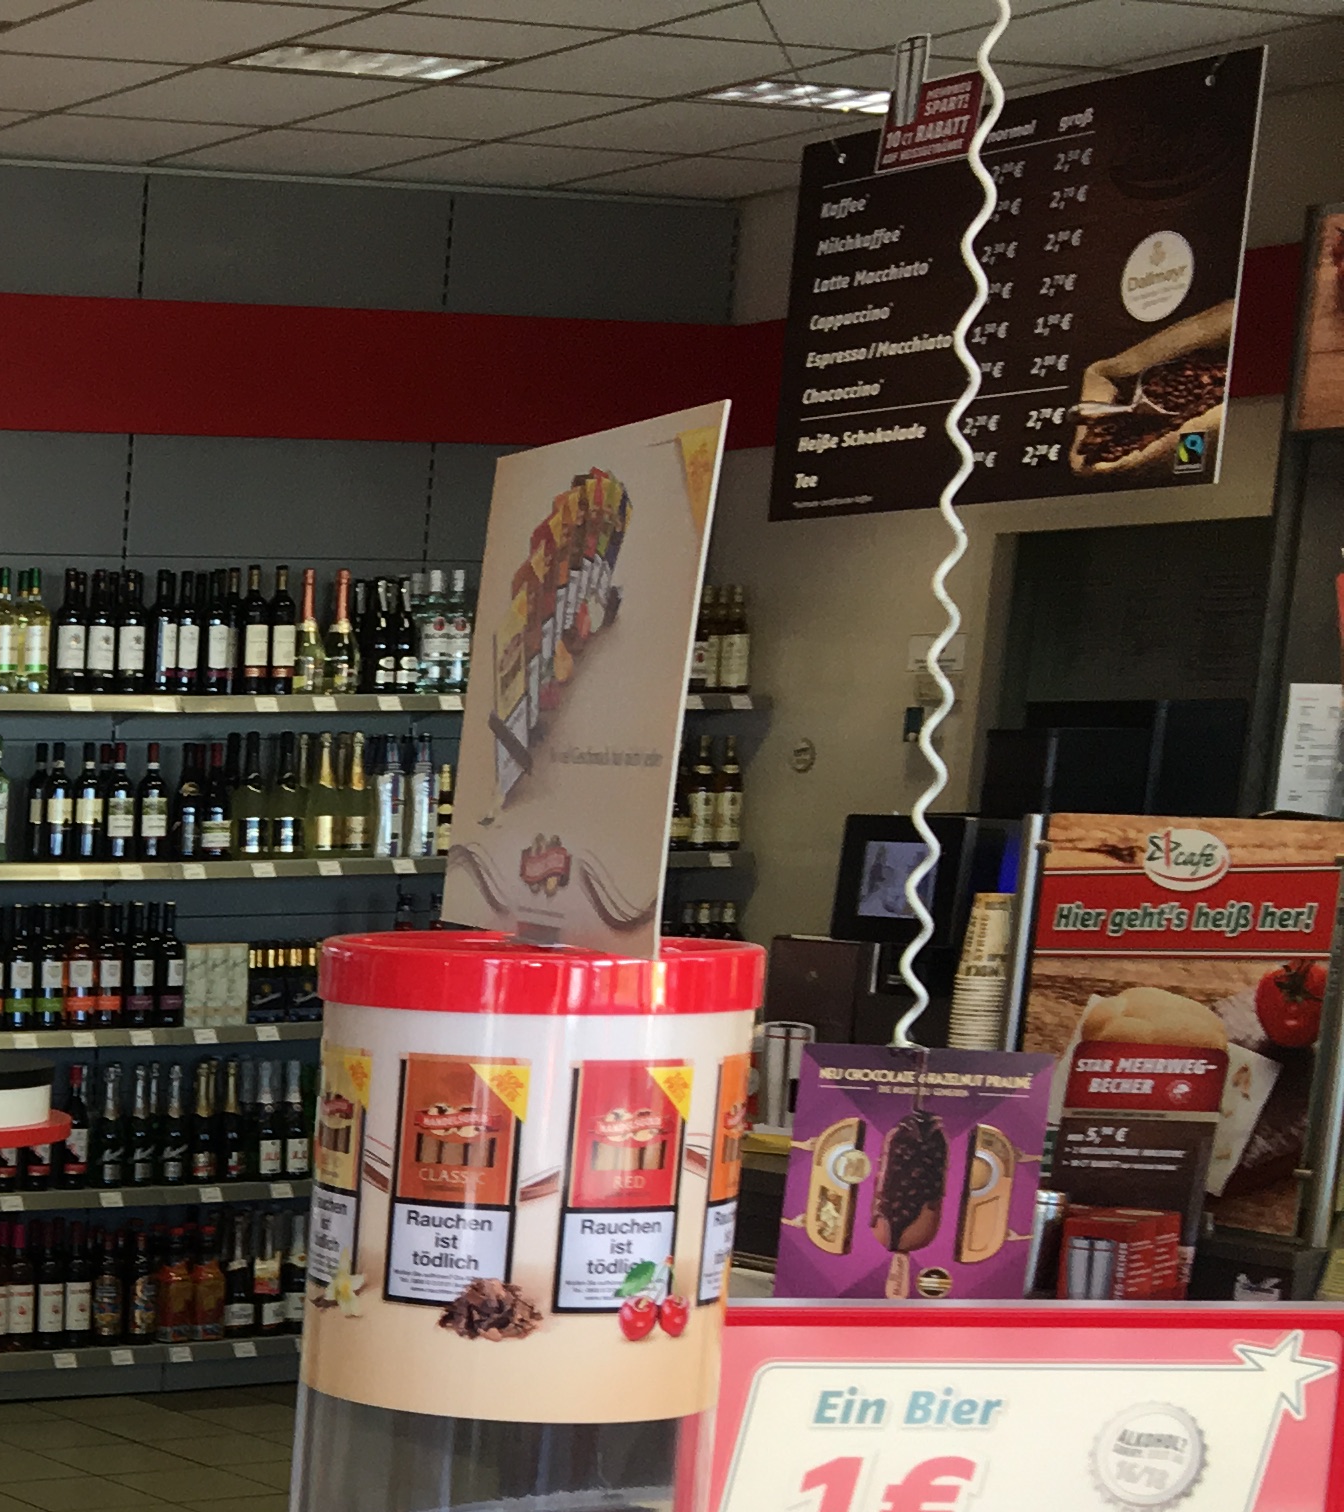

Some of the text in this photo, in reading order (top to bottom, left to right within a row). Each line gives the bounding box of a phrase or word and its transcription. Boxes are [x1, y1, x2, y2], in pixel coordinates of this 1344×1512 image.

[915, 115, 970, 142] RABATT
[986, 119, 1037, 144] normal
[842, 423, 926, 447] Schokolade
[795, 473, 818, 488] Tee
[1173, 842, 1218, 886] café
[1053, 903, 1317, 938] Hier geht's heiß her!
[1088, 1078, 1155, 1095] BECHER
[418, 1167, 486, 1186] CLASSC
[613, 1175, 646, 1190] RED
[406, 1209, 493, 1232] Rauchen
[580, 1218, 662, 1236] Rauchen
[434, 1232, 459, 1250] ist
[609, 1238, 633, 1255] ist
[412, 1250, 479, 1271] tödlich
[812, 1387, 1003, 1428] Ein Bier
